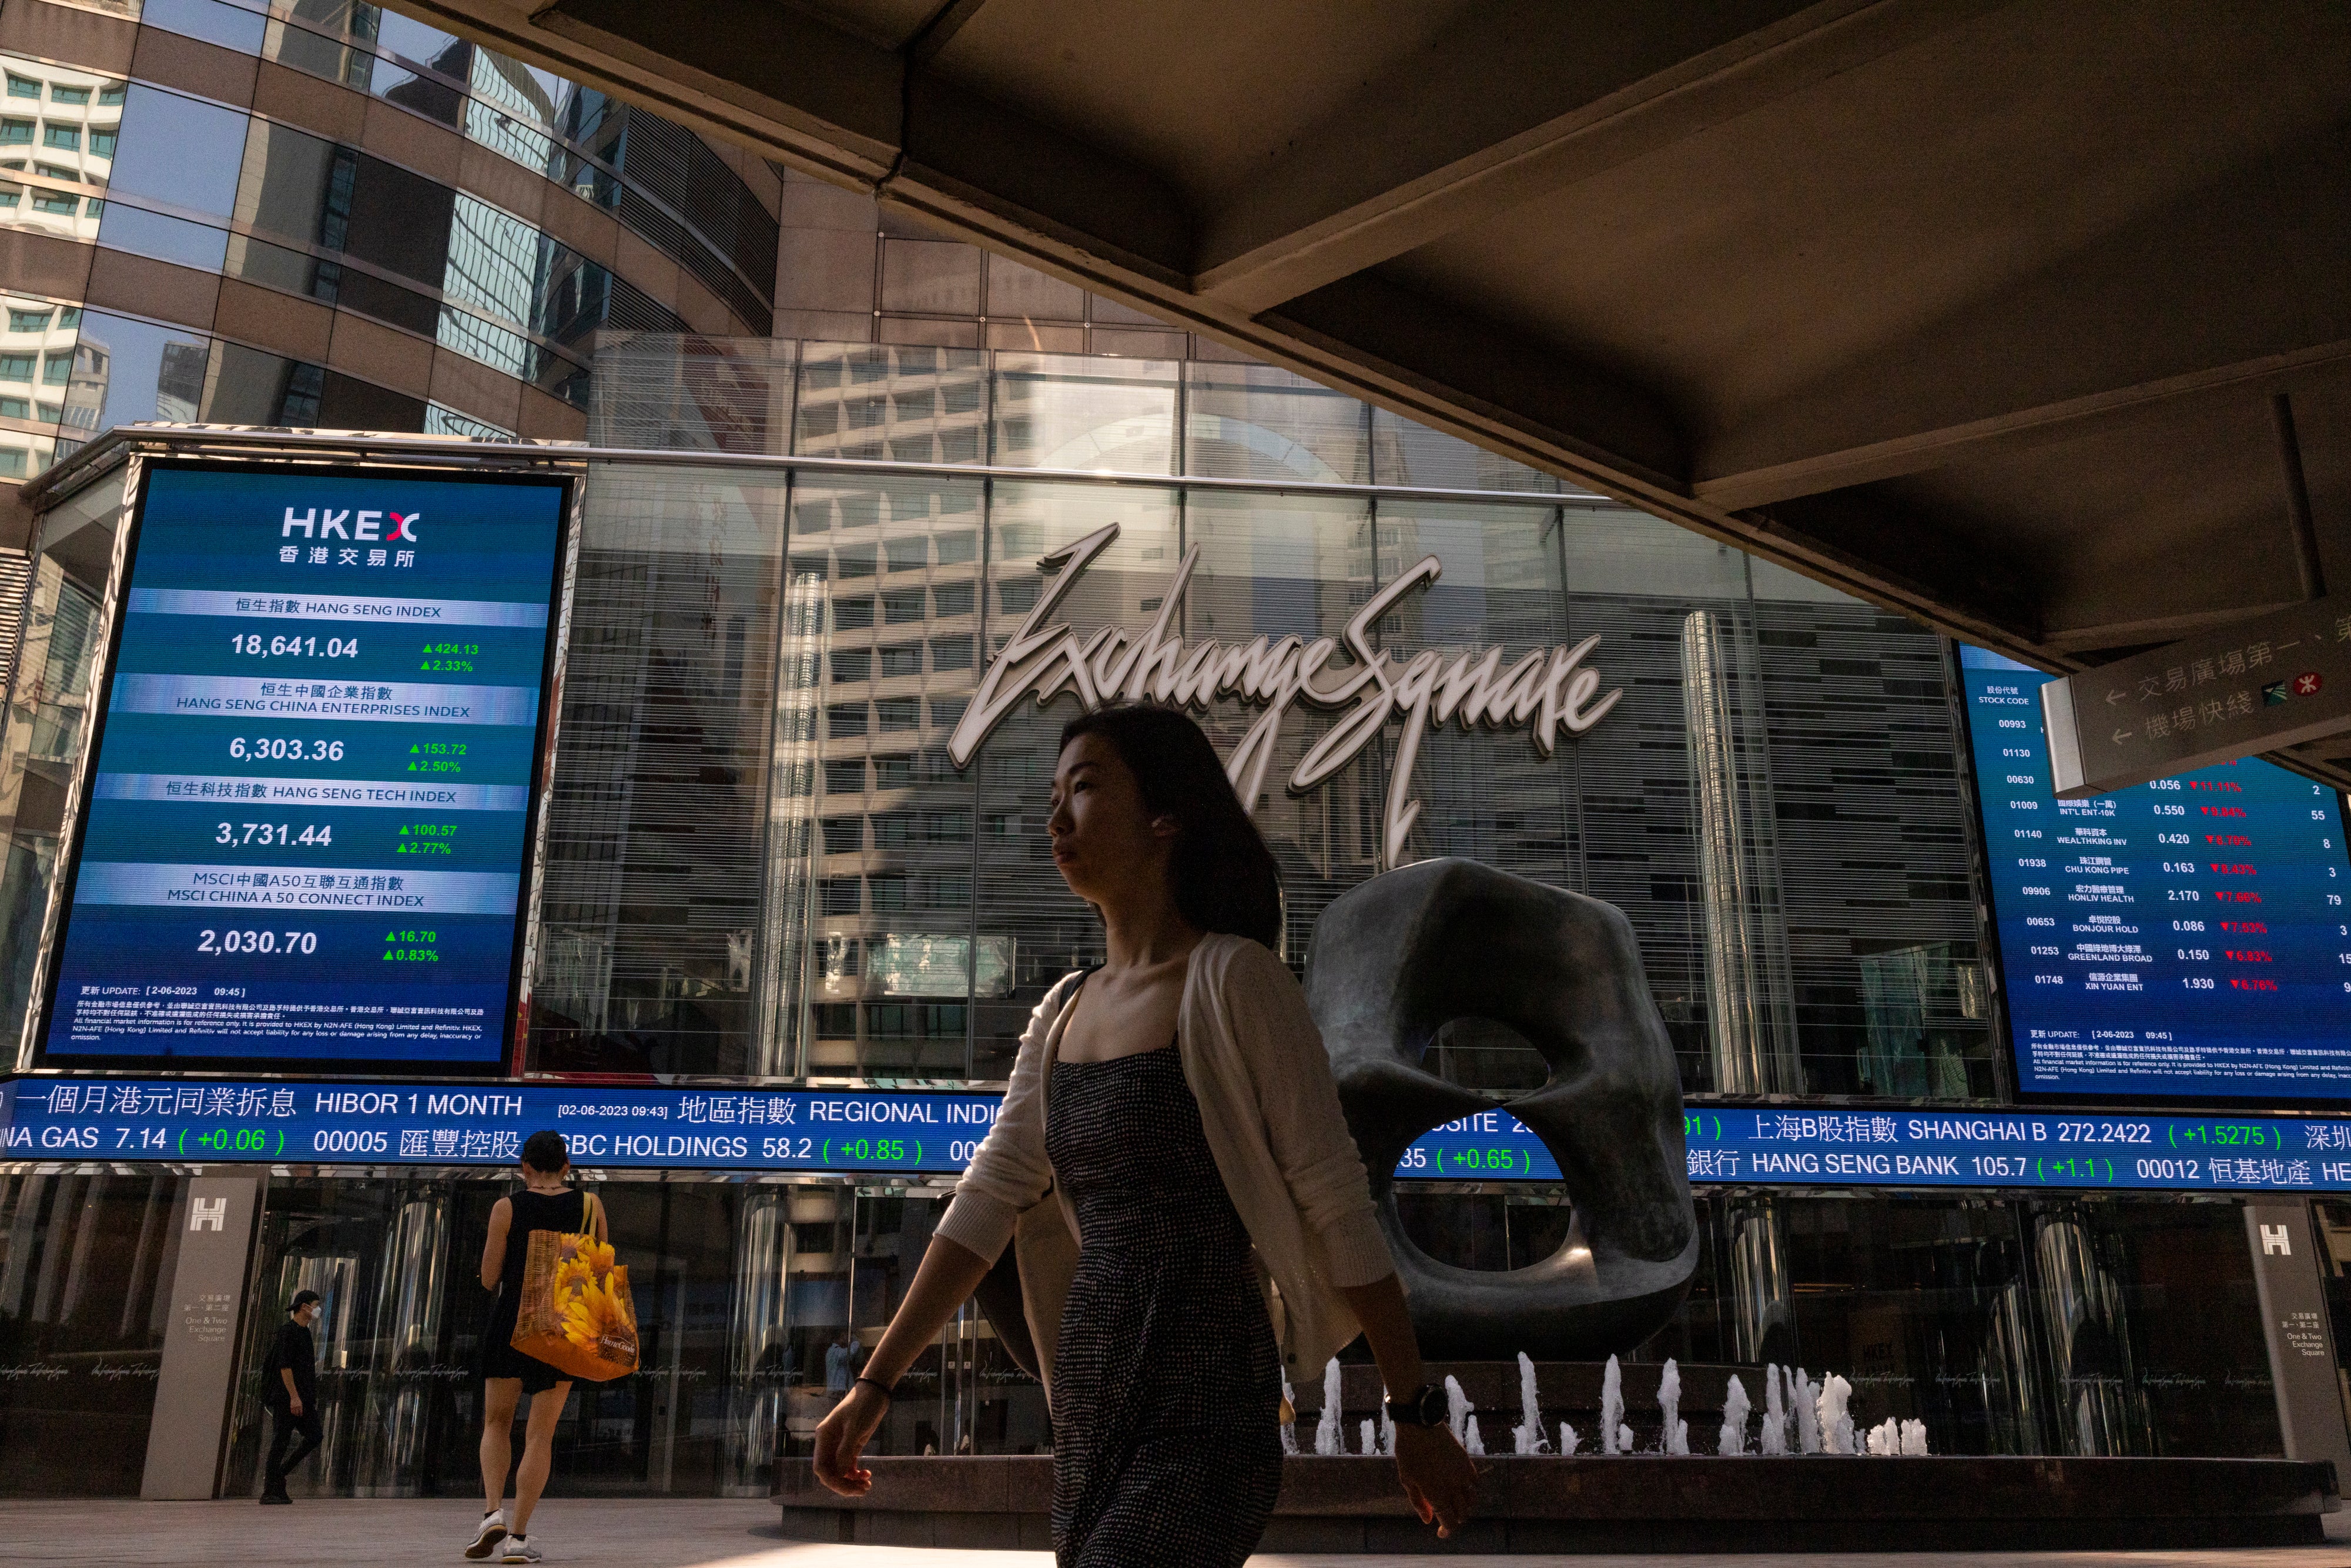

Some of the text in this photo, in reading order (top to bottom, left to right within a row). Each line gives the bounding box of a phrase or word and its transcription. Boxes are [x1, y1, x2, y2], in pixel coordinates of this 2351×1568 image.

[283, 508, 419, 542] HKEX
[280, 546, 414, 567] 香港交易所
[236, 598, 441, 617] 恒生指數 HANG SENG INDEX
[232, 635, 358, 658] 18,641.04
[436, 644, 478, 654] 424.13
[433, 660, 473, 671] 2.33%
[261, 682, 392, 700] 恒生中國企業指數
[947, 521, 1623, 870] Exchange Square
[1987, 686, 2018, 694] 股份代號
[177, 698, 470, 717] HANG SENG CHINA ENTERPRISES INDEX
[1998, 720, 2026, 728] 00993
[230, 738, 343, 761] 6,303.36
[424, 743, 466, 755] 153.72
[2003, 749, 2030, 757] 01130
[420, 761, 460, 772] 2.50%
[2006, 775, 2034, 784] 00630
[2149, 780, 2180, 789] 0.056
[166, 782, 456, 802] 恒生科技指數 HANG SENG TECH INDEX
[2011, 801, 2038, 809] 01009
[2154, 805, 2184, 815] 0.550
[216, 823, 331, 847] 3,731.44
[414, 825, 457, 836] 100.57
[2015, 830, 2042, 838] 01140
[2159, 833, 2189, 843] 0.420
[410, 842, 451, 854] 2.77%
[2019, 859, 2046, 867] 01938
[2164, 863, 2194, 873] 0.163
[193, 872, 403, 892] MSCI中國A50互聯互通指數
[2022, 886, 2051, 896] 09906
[2168, 890, 2199, 900] 2.170
[168, 890, 424, 906] MSCI CHINA A 50 CONNECT INDEX
[2027, 917, 2055, 926] 00653
[2173, 921, 2204, 931] 0.086
[400, 931, 436, 942] 16.70
[198, 930, 316, 955] 2,030.70
[397, 950, 438, 961] 0.83%
[2031, 947, 2059, 955] 01253
[2178, 949, 2209, 960] 0.150
[2035, 976, 2063, 984] 01748
[2183, 978, 2213, 989] 1.930
[81, 986, 99, 994] 更新
[17, 1085, 296, 1117] 一個月港元同業折息
[316, 1093, 398, 1113] HIBOR
[408, 1094, 417, 1113] 1
[428, 1094, 521, 1115] MONTH
[558, 1105, 667, 1119] [02-06-2023 09:43]
[678, 1096, 796, 1124] 地區指數
[811, 1101, 938, 1123] REGIONAL
[1749, 1115, 1898, 1142] 上海B股指數
[1909, 1120, 2025, 1140] SHANGHAI
[2032, 1123, 2047, 1140] B
[2058, 1123, 2151, 1143] 272.2422
[42, 1127, 98, 1148] GAS
[116, 1128, 166, 1148] 7.14
[314, 1131, 387, 1152] 00005
[400, 1130, 524, 1161] 匯豐控股
[615, 1135, 747, 1157] HOLDINGS
[763, 1138, 811, 1158] 58.2
[1753, 1154, 1818, 1172] HANG
[1826, 1154, 1890, 1174] SENG
[1896, 1155, 1959, 1174] BANK
[1972, 1157, 2026, 1175] 105.7
[2137, 1160, 2199, 1178] 00012
[2209, 1158, 2313, 1184] 恒基地產
[189, 1326, 226, 1334] Exchange
[197, 1335, 225, 1343] Square
[600, 1336, 635, 1353] HomeGoods
